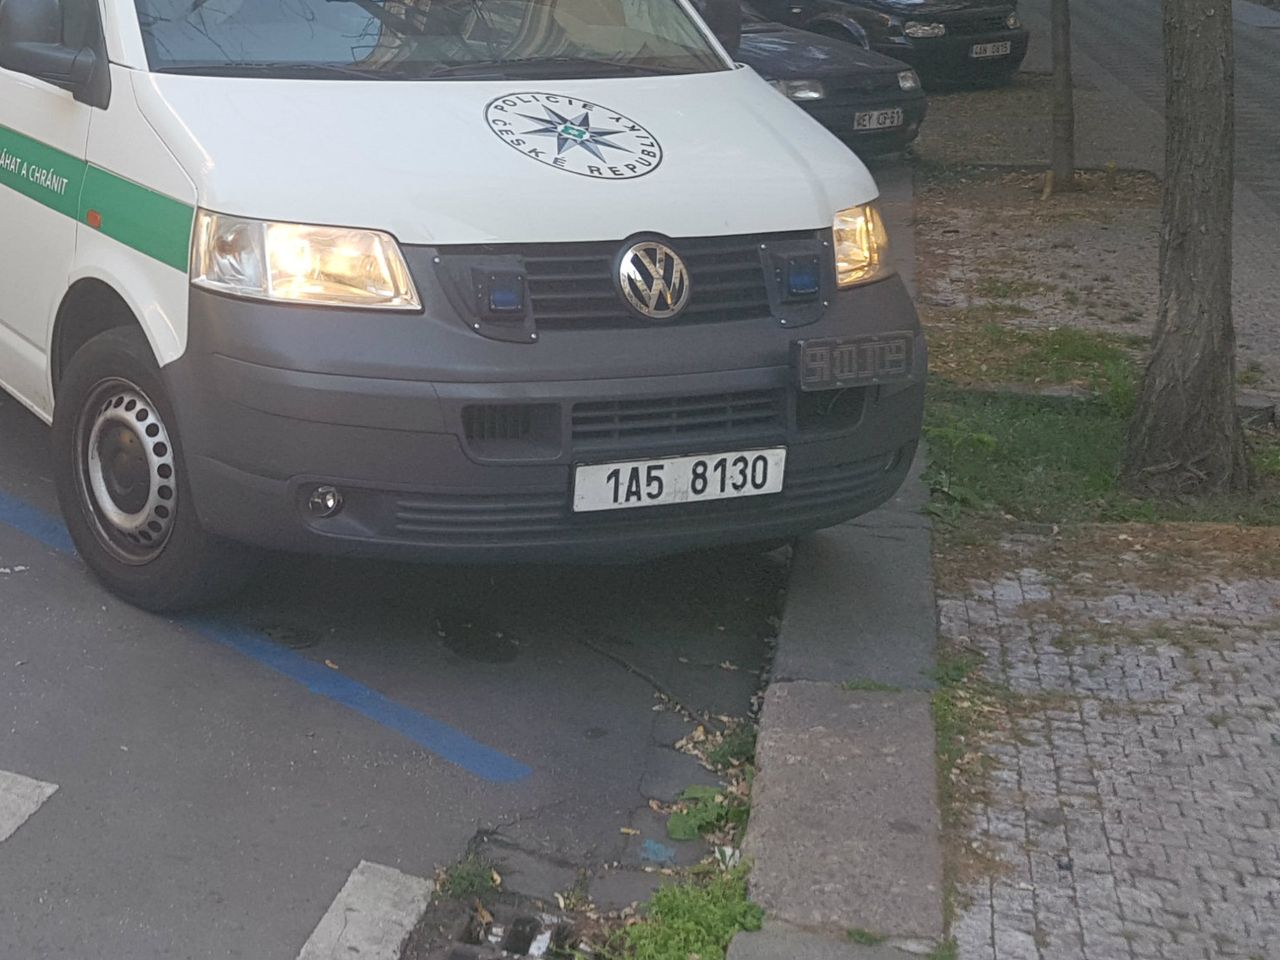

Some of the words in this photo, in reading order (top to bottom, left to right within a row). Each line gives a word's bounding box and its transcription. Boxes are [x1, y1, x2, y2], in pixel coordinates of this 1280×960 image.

[493, 94, 596, 114] POLICIE
[491, 118, 568, 168] ČESKÉ
[586, 116, 658, 177] REPUBLIKY
[20, 161, 28, 178] A
[28, 165, 69, 196] CHRÁNIT
[606, 464, 664, 504] 1A5
[690, 454, 769, 496] 8130
